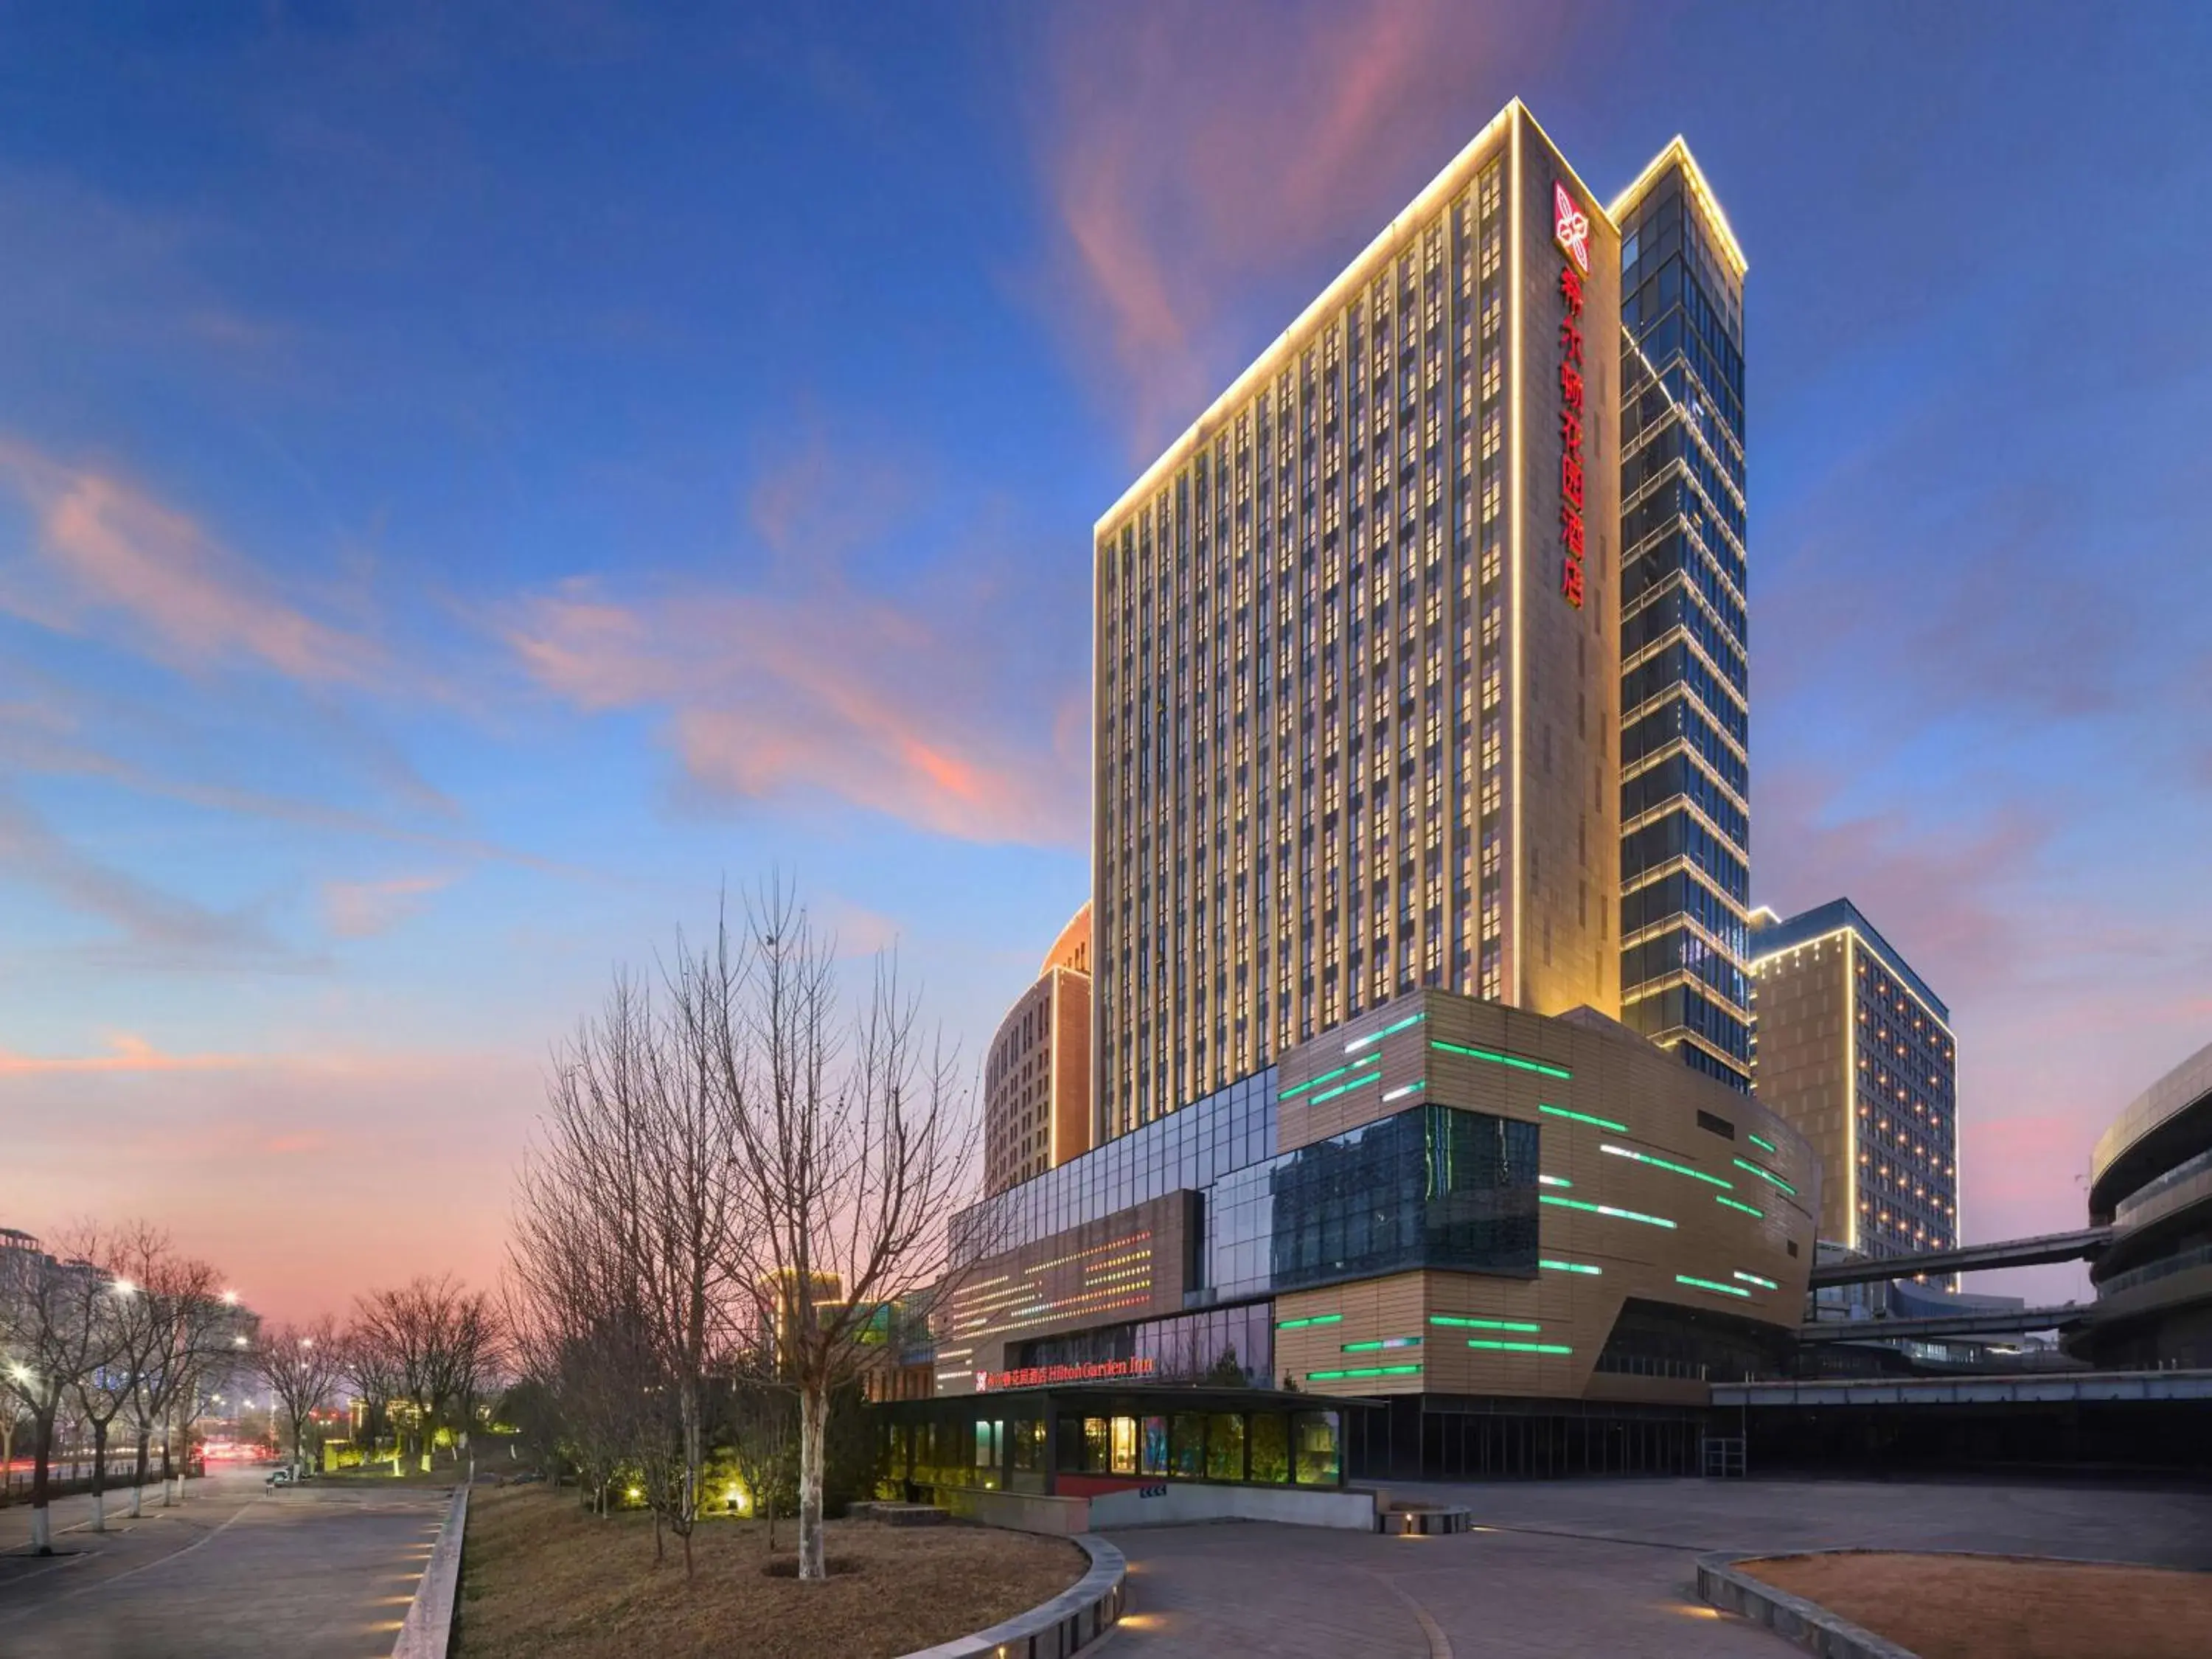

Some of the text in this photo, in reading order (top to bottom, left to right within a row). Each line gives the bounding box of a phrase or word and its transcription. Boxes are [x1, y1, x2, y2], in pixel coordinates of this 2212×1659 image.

[1560, 266, 1585, 610] 希尔顿花园酒店
[1049, 1356, 1155, 1381] Hilton Garden Inn
